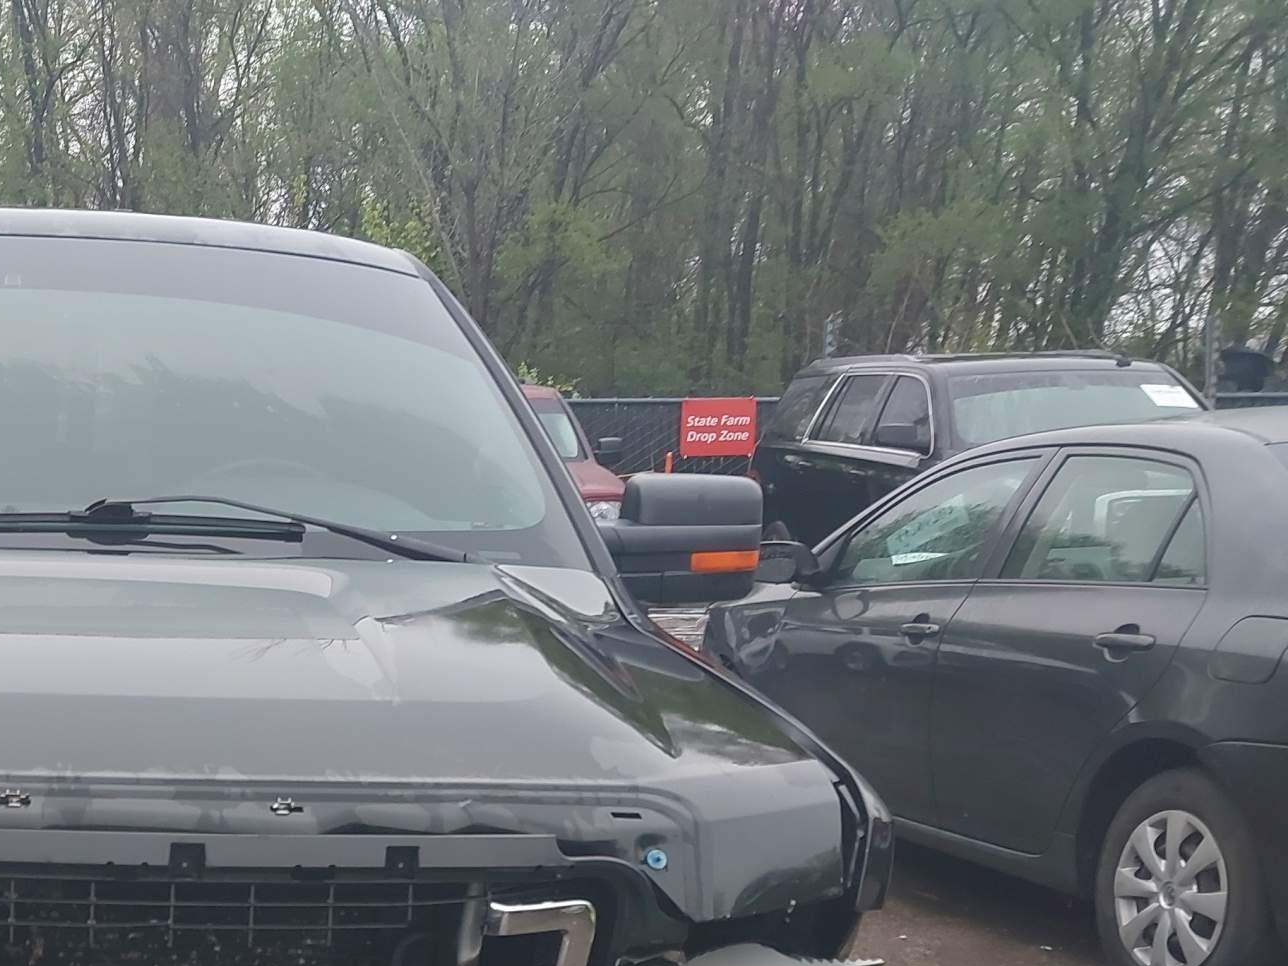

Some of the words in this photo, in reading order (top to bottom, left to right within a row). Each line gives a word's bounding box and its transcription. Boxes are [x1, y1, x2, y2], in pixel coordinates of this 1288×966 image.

[687, 415, 718, 427] State
[720, 415, 750, 425] Farm
[686, 431, 717, 444] Drop
[718, 430, 749, 440] Zone
